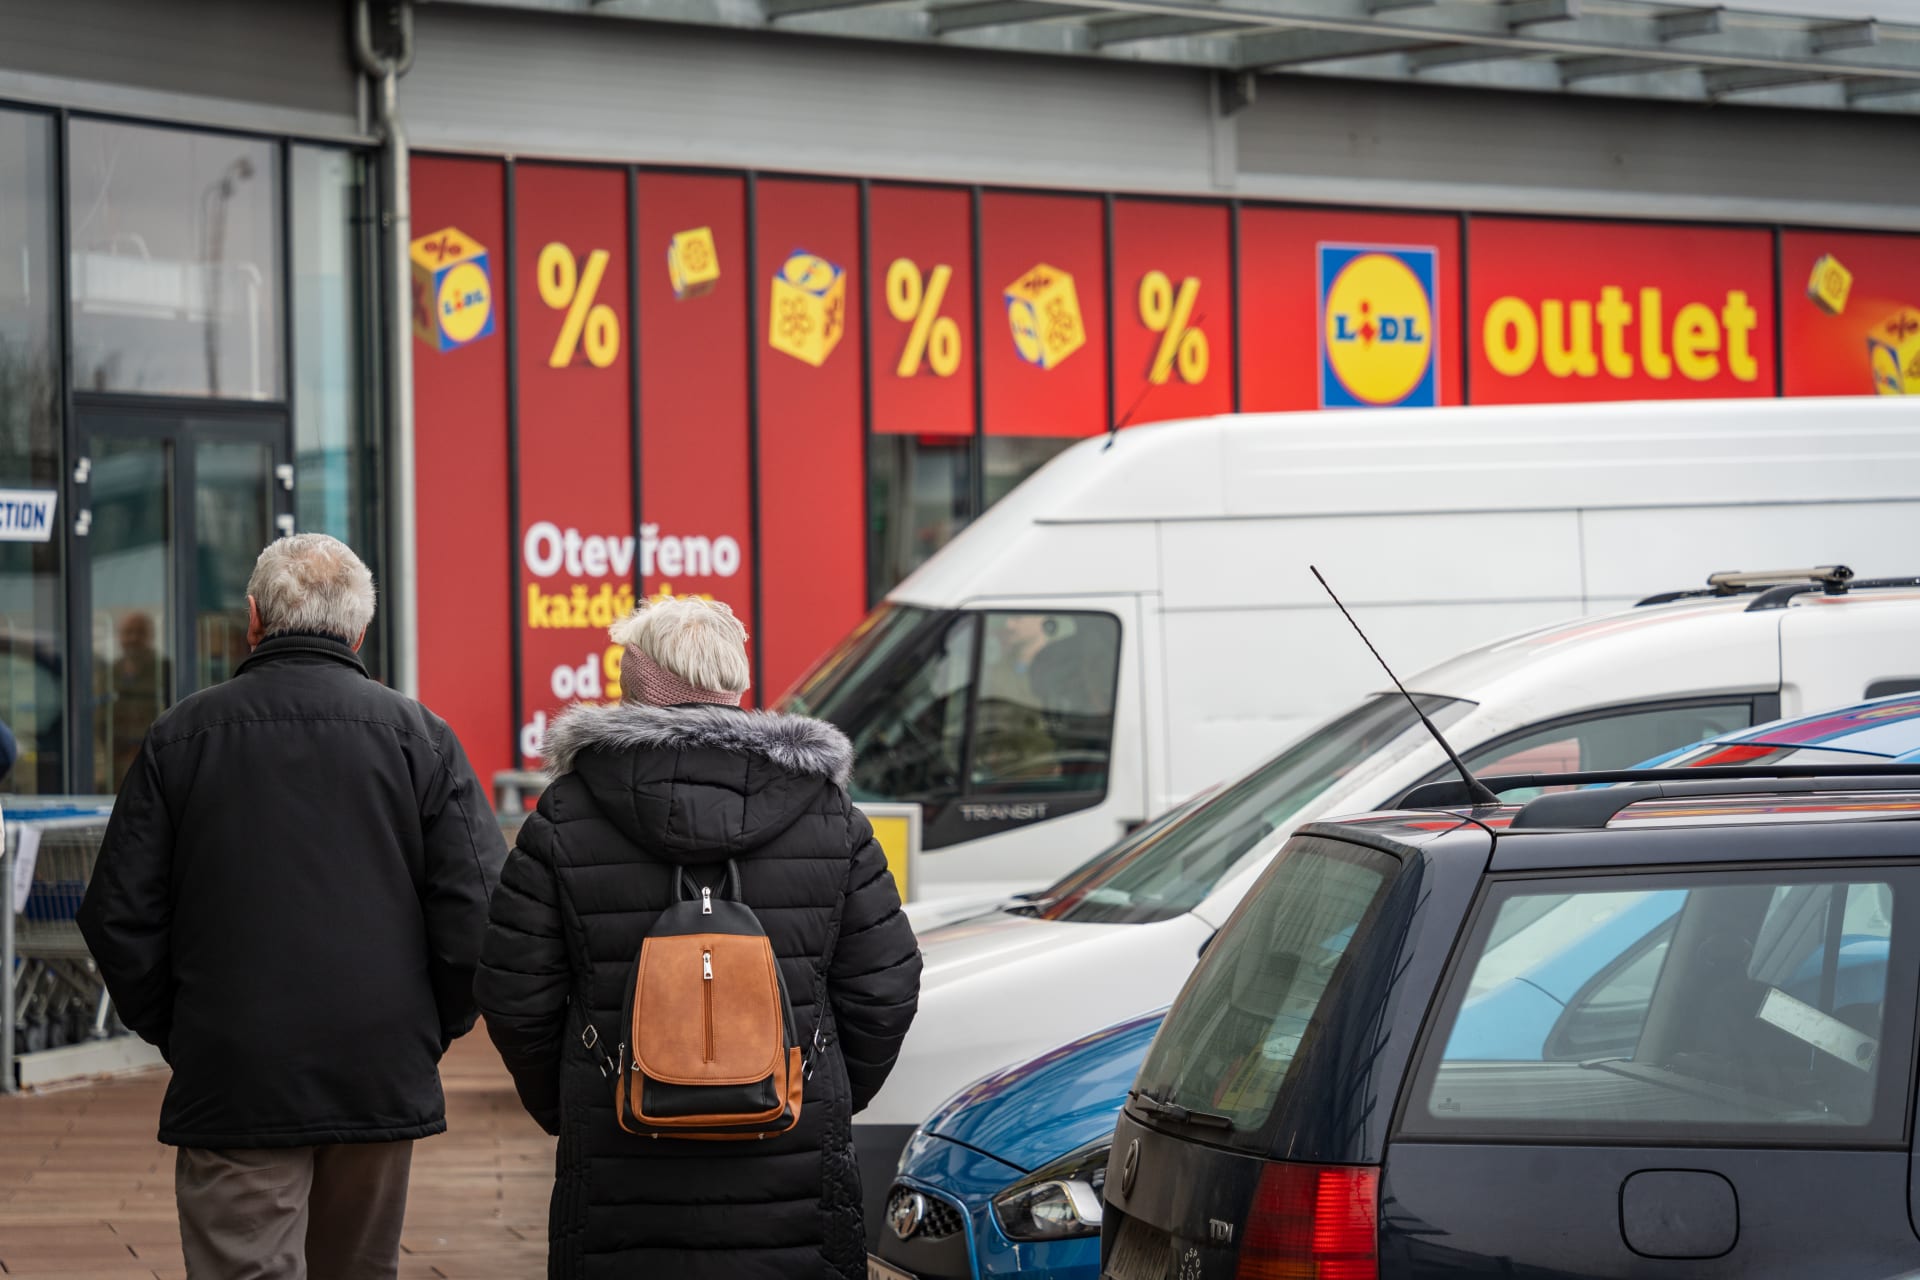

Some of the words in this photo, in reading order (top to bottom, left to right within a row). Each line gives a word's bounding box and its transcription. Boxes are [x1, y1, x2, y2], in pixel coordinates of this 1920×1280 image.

[1483, 285, 1758, 382] outlet
[524, 521, 741, 577] Otevřeno
[528, 582, 636, 629] každý
[551, 653, 600, 699] od
[959, 802, 1049, 821] TRANSIT
[1208, 1218, 1234, 1243] TDI
